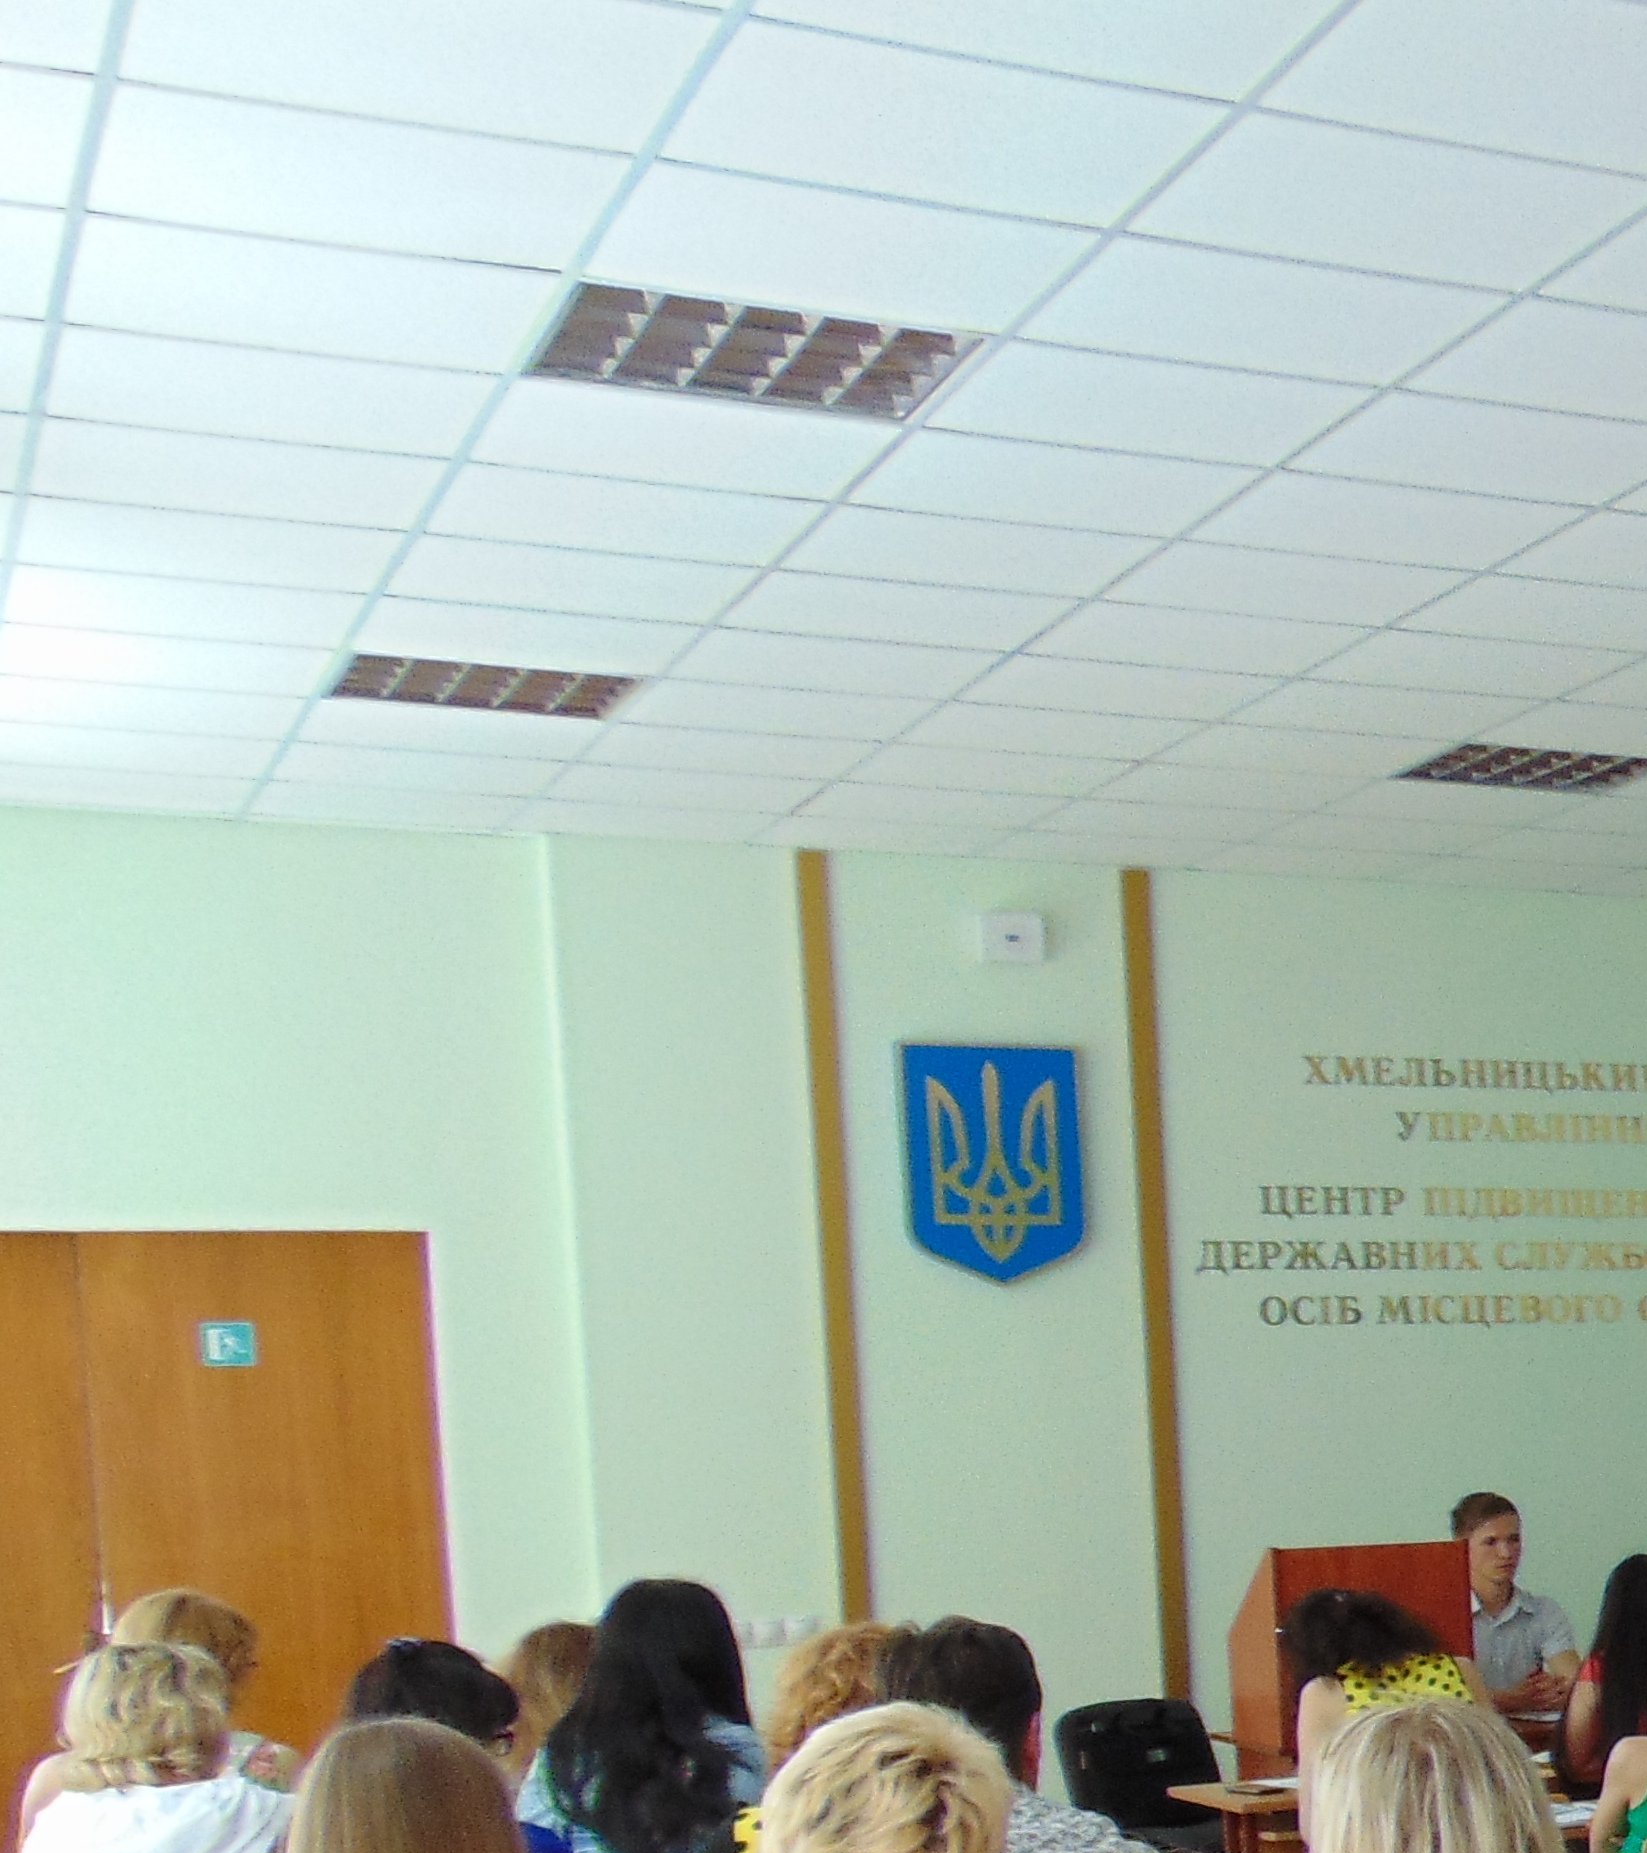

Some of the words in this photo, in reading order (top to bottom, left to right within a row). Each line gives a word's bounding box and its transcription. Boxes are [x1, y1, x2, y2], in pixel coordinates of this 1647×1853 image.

[1257, 1184, 1406, 1220] ЦЕНТР
[1195, 1239, 1483, 1275] ДЕРЖАВНИХ
[1257, 1294, 1364, 1327] ОСІБ
[1376, 1294, 1622, 1329] МІСЦЕВОГО
